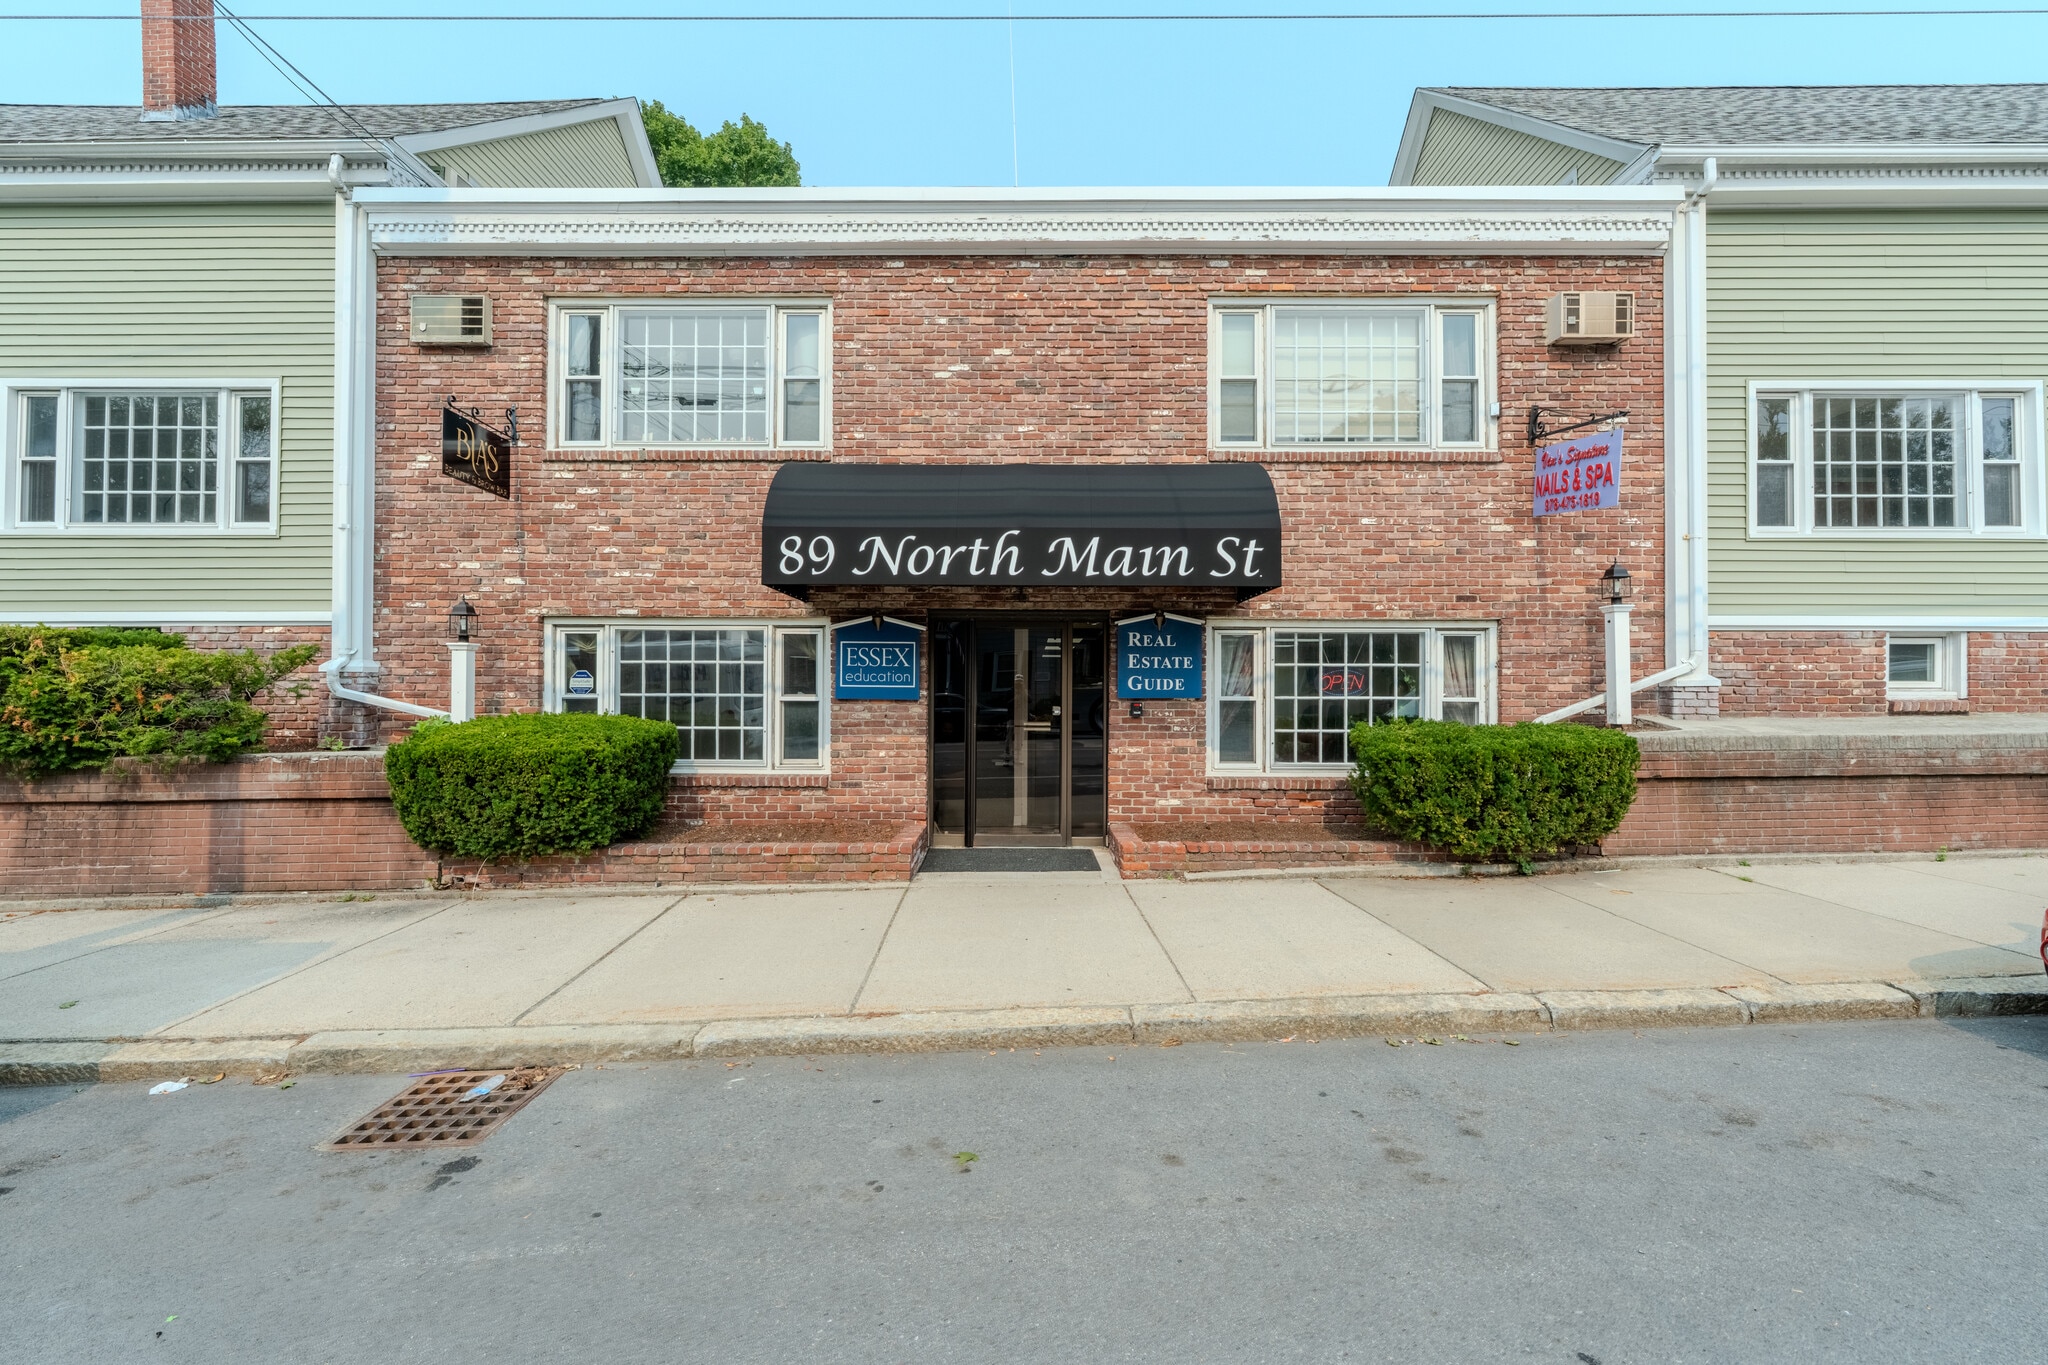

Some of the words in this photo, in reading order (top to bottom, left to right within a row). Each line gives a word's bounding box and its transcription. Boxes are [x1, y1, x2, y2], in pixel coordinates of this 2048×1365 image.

[445, 463, 471, 481] BEAUTY
[1535, 469, 1570, 498] NAILS
[1572, 467, 1581, 491] &
[1585, 461, 1614, 490] SPA
[1544, 491, 1601, 513] 978-475-1819
[779, 535, 835, 576] 89
[852, 530, 1024, 576] North
[1041, 536, 1194, 577] Main
[1127, 631, 1177, 647] REAL
[846, 647, 910, 667] ESSEX
[1127, 653, 1194, 669] ESTATE
[845, 668, 911, 682] education
[1127, 675, 1185, 691] GUIDE
[1321, 674, 1365, 691] OPEN
